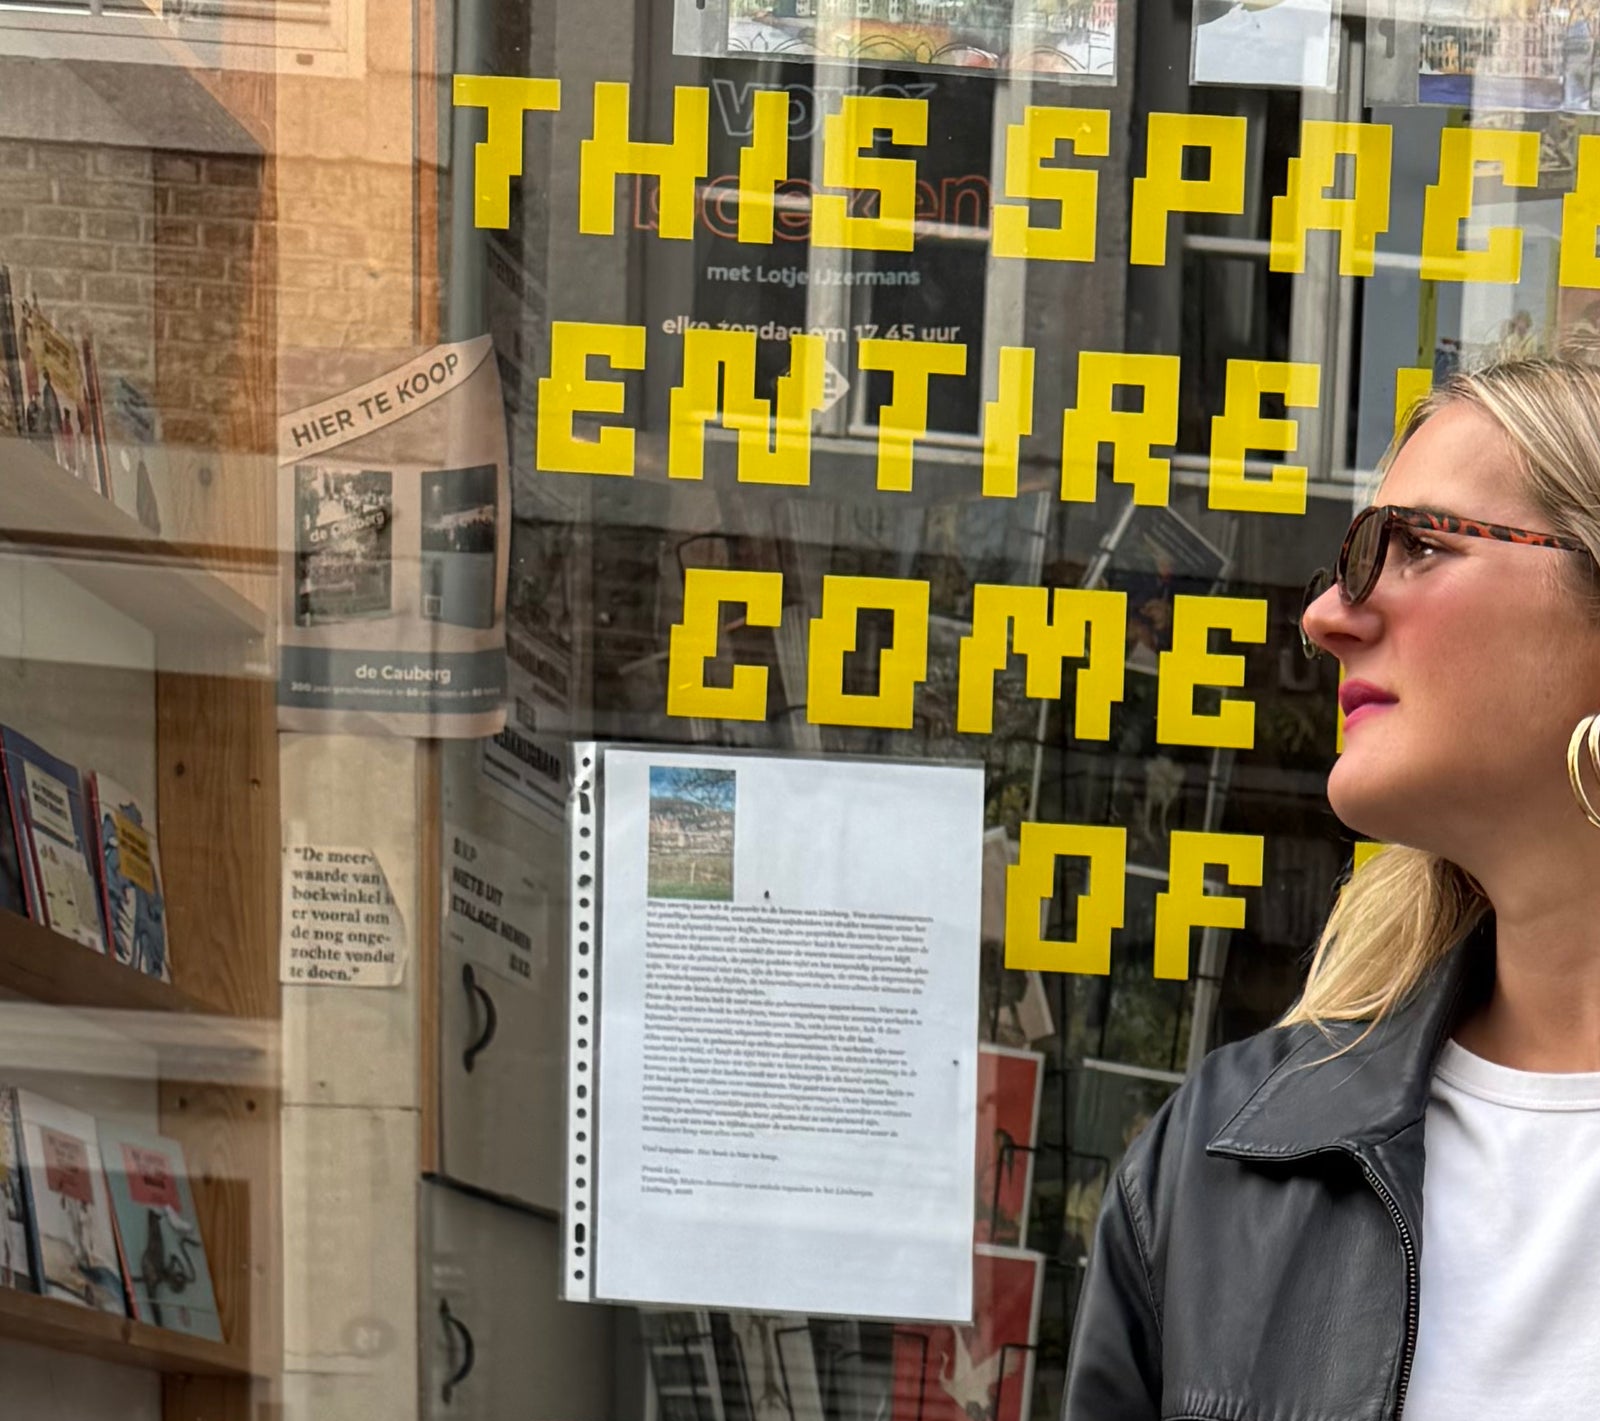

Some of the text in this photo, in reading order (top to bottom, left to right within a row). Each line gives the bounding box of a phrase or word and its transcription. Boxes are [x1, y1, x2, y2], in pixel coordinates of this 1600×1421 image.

[453, 76, 928, 251] THIS
[707, 265, 750, 282] met
[757, 265, 808, 288] Lotje
[922, 325, 960, 342] uur
[291, 353, 459, 447] HIER TE KOOP
[537, 322, 1318, 514] ENTIRE
[667, 568, 1267, 748] COME
[355, 664, 452, 684] de Cauberg
[292, 868, 381, 885] waarde van
[291, 885, 381, 905] boekwinkel
[1005, 822, 1264, 979] OF
[292, 909, 389, 925] er vooral om
[291, 925, 310, 939] de
[313, 930, 343, 944] nog
[290, 945, 396, 963] zochte vondst
[290, 966, 304, 978] te
